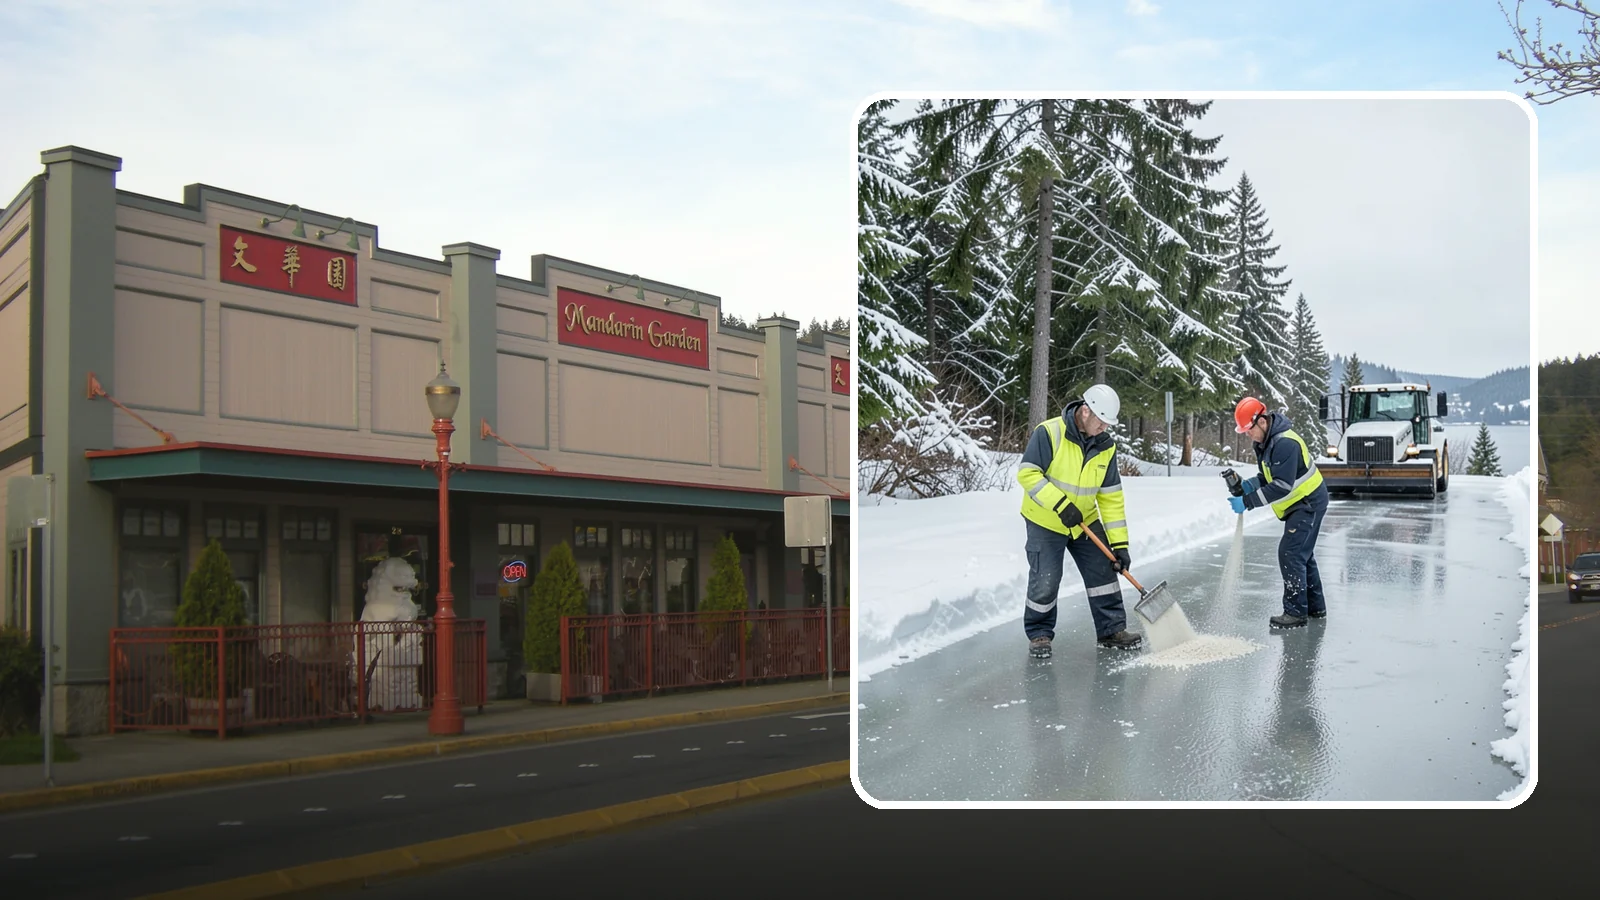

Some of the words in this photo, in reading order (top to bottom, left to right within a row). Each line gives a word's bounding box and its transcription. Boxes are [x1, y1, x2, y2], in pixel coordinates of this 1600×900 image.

[230, 236, 346, 291] 文華園
[564, 302, 644, 341] Mandarin
[648, 320, 702, 352] Garden
[503, 565, 527, 578] OPEN
